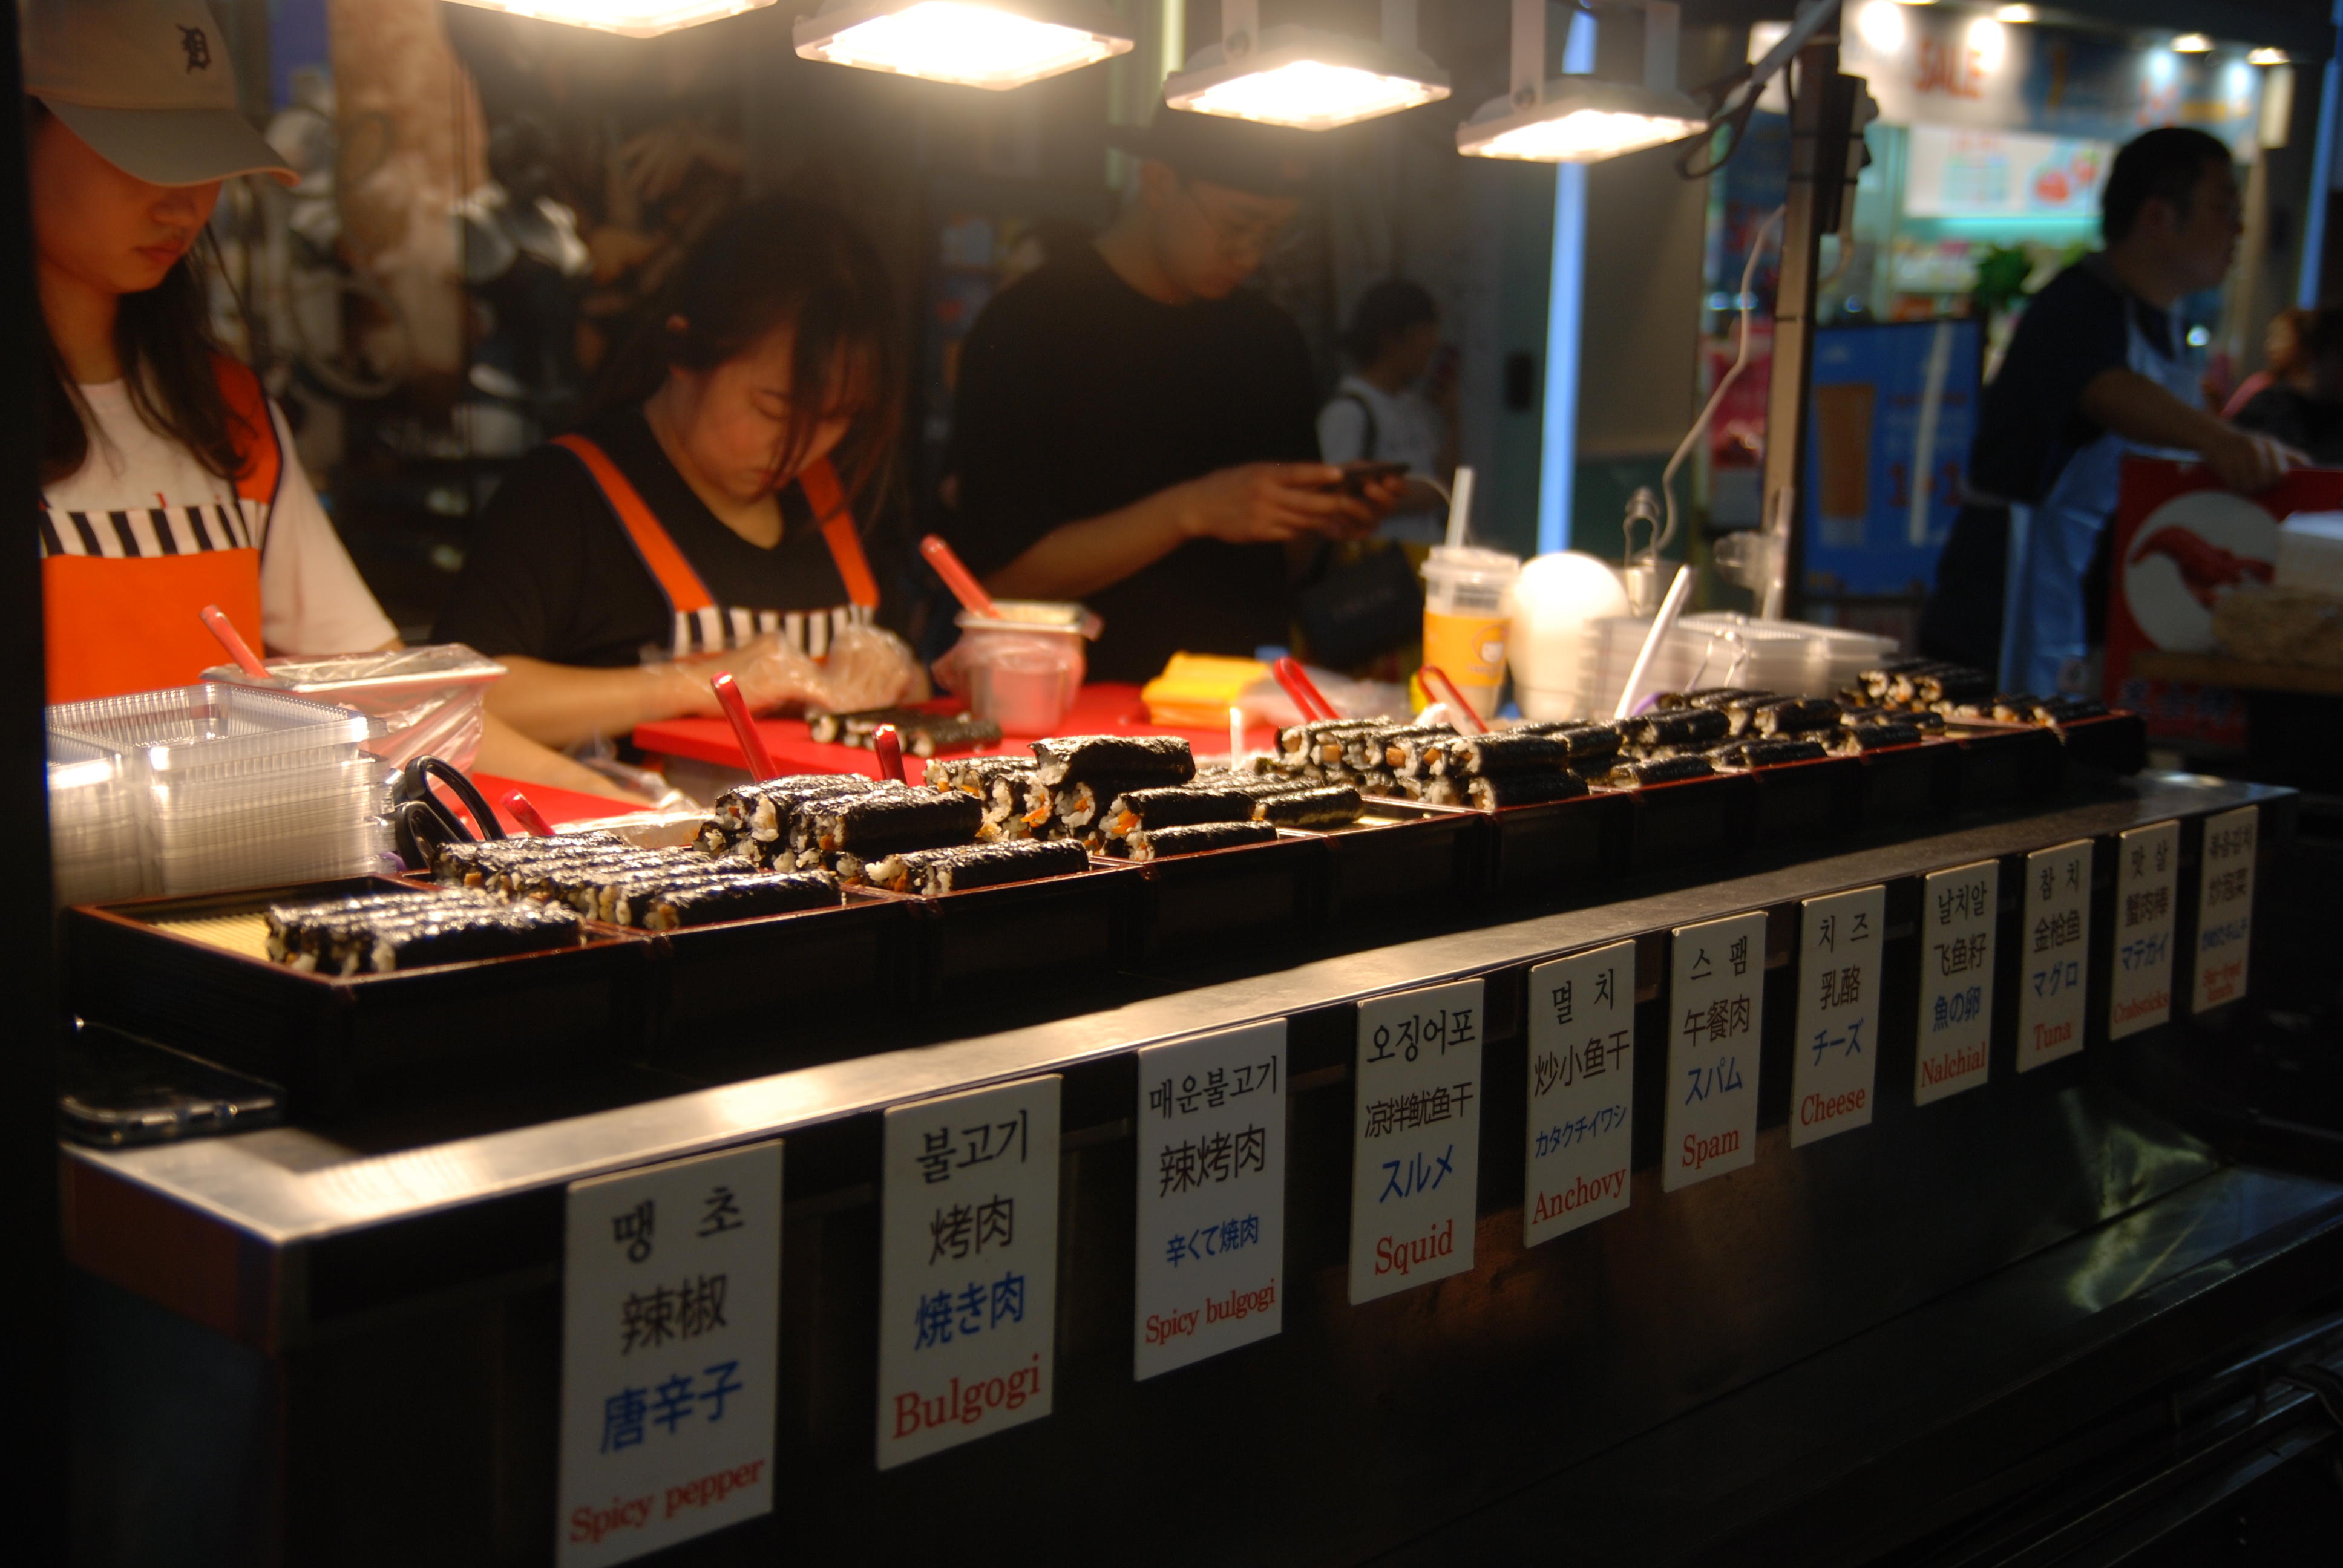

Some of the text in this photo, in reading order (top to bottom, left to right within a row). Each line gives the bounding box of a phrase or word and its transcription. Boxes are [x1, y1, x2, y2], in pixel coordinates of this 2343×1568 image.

[1939, 881, 1987, 925] 날치알
[1934, 933, 1987, 976] 飞鱼籽
[2034, 910, 2081, 953] 金枪鱼
[1821, 965, 1861, 1010] 乳酪
[2033, 961, 2079, 998] マグロ
[1366, 1009, 1475, 1063] 오징어포
[1683, 994, 1750, 1047] 午餐肉
[1933, 986, 1981, 1033] 魚の卵
[2034, 1021, 2072, 1051] Tuna
[1534, 1030, 1630, 1097] 炒小鱼干
[1812, 1017, 1864, 1066] チーズ
[1921, 1041, 1987, 1088] Nalchial
[1149, 1055, 1277, 1120] 매운불고기
[1685, 1057, 1743, 1105] スパム
[1800, 1088, 1866, 1126] Cheese
[1365, 1082, 1473, 1138] 凉拌鱿鱼干
[1535, 1104, 1627, 1159] カタクチイワシ
[916, 1109, 1027, 1184] 불고기
[1159, 1124, 1266, 1199] 辣烤肉
[1379, 1144, 1453, 1203] スルメ
[1682, 1129, 1739, 1170] Spam
[1532, 1168, 1627, 1224] Anchovy
[928, 1194, 1014, 1265] 烤肉
[1165, 1214, 1259, 1267] 辛くて焼肉
[1375, 1219, 1453, 1276] Squid
[621, 1274, 727, 1356] 辣椒
[914, 1272, 1026, 1351] 焼き肉
[1145, 1278, 1275, 1345] Spicy bulgogi
[600, 1361, 742, 1454] 唐辛子
[892, 1353, 1041, 1439] Bulgogi
[570, 1459, 764, 1544] Spicy pepper
